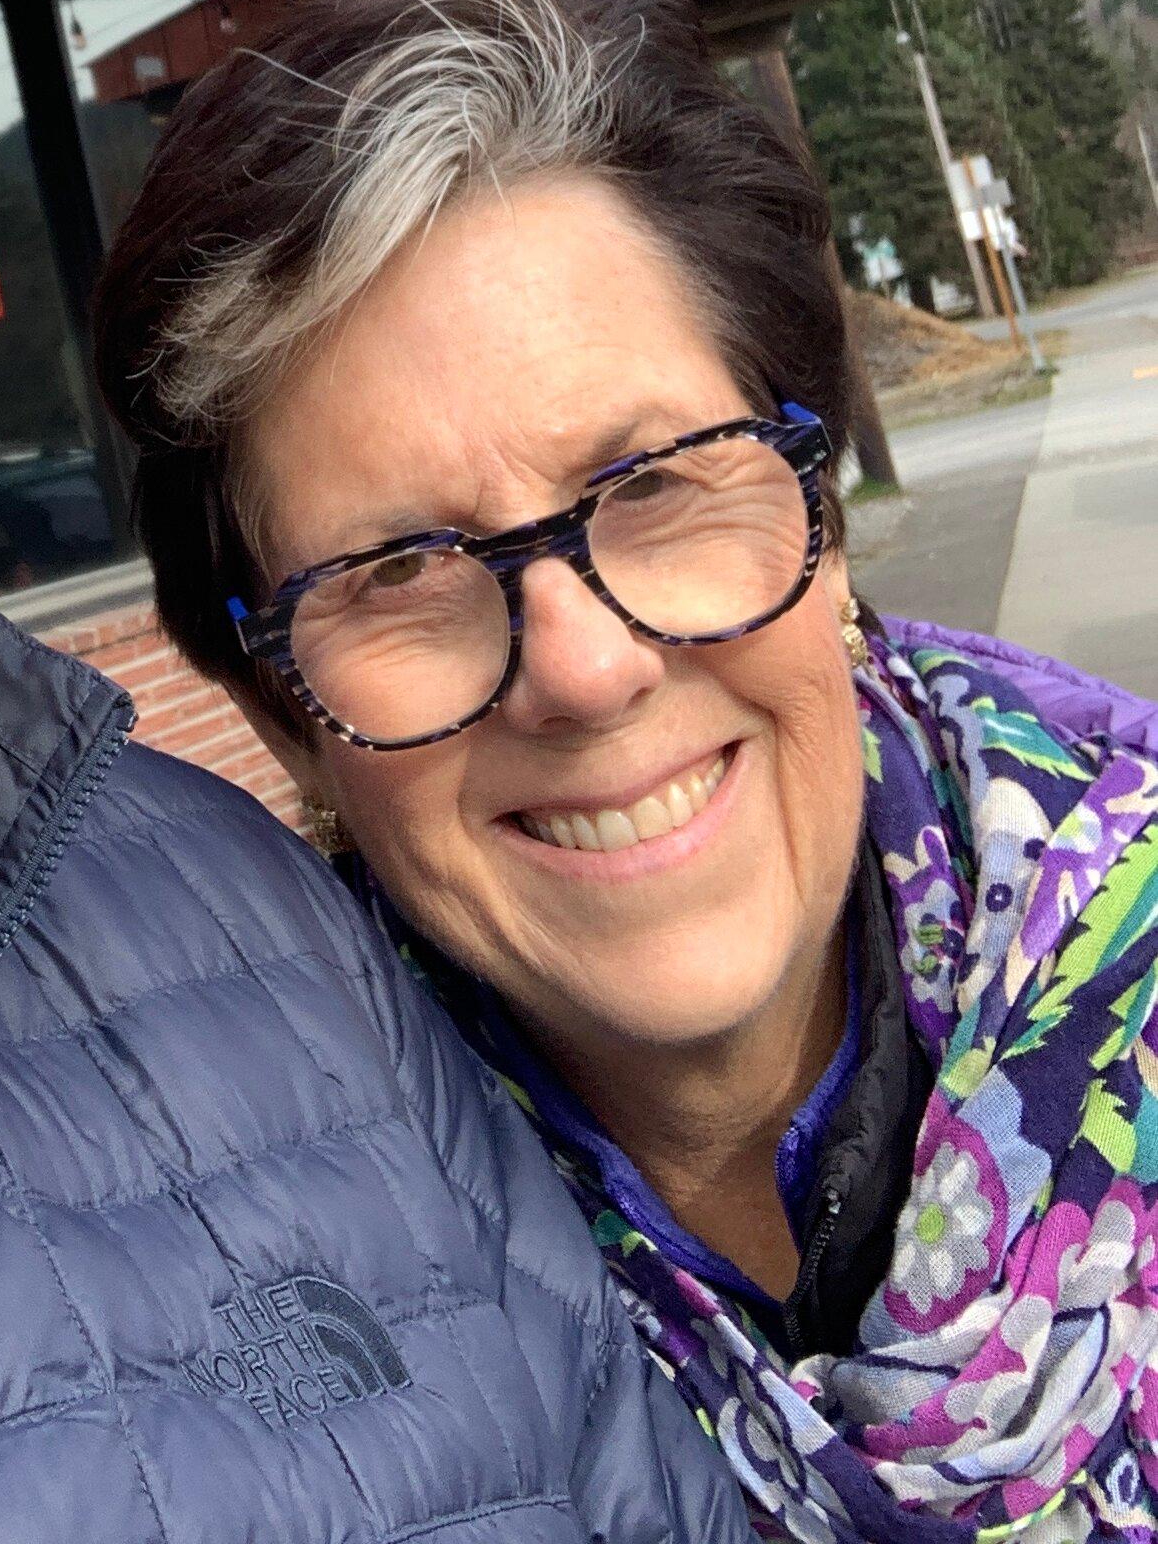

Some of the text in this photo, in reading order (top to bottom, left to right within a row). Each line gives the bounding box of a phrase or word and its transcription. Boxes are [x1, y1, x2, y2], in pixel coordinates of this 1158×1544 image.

[212, 1281, 306, 1343] THE
[179, 1318, 330, 1398] NORTH
[243, 1367, 355, 1434] FACE
